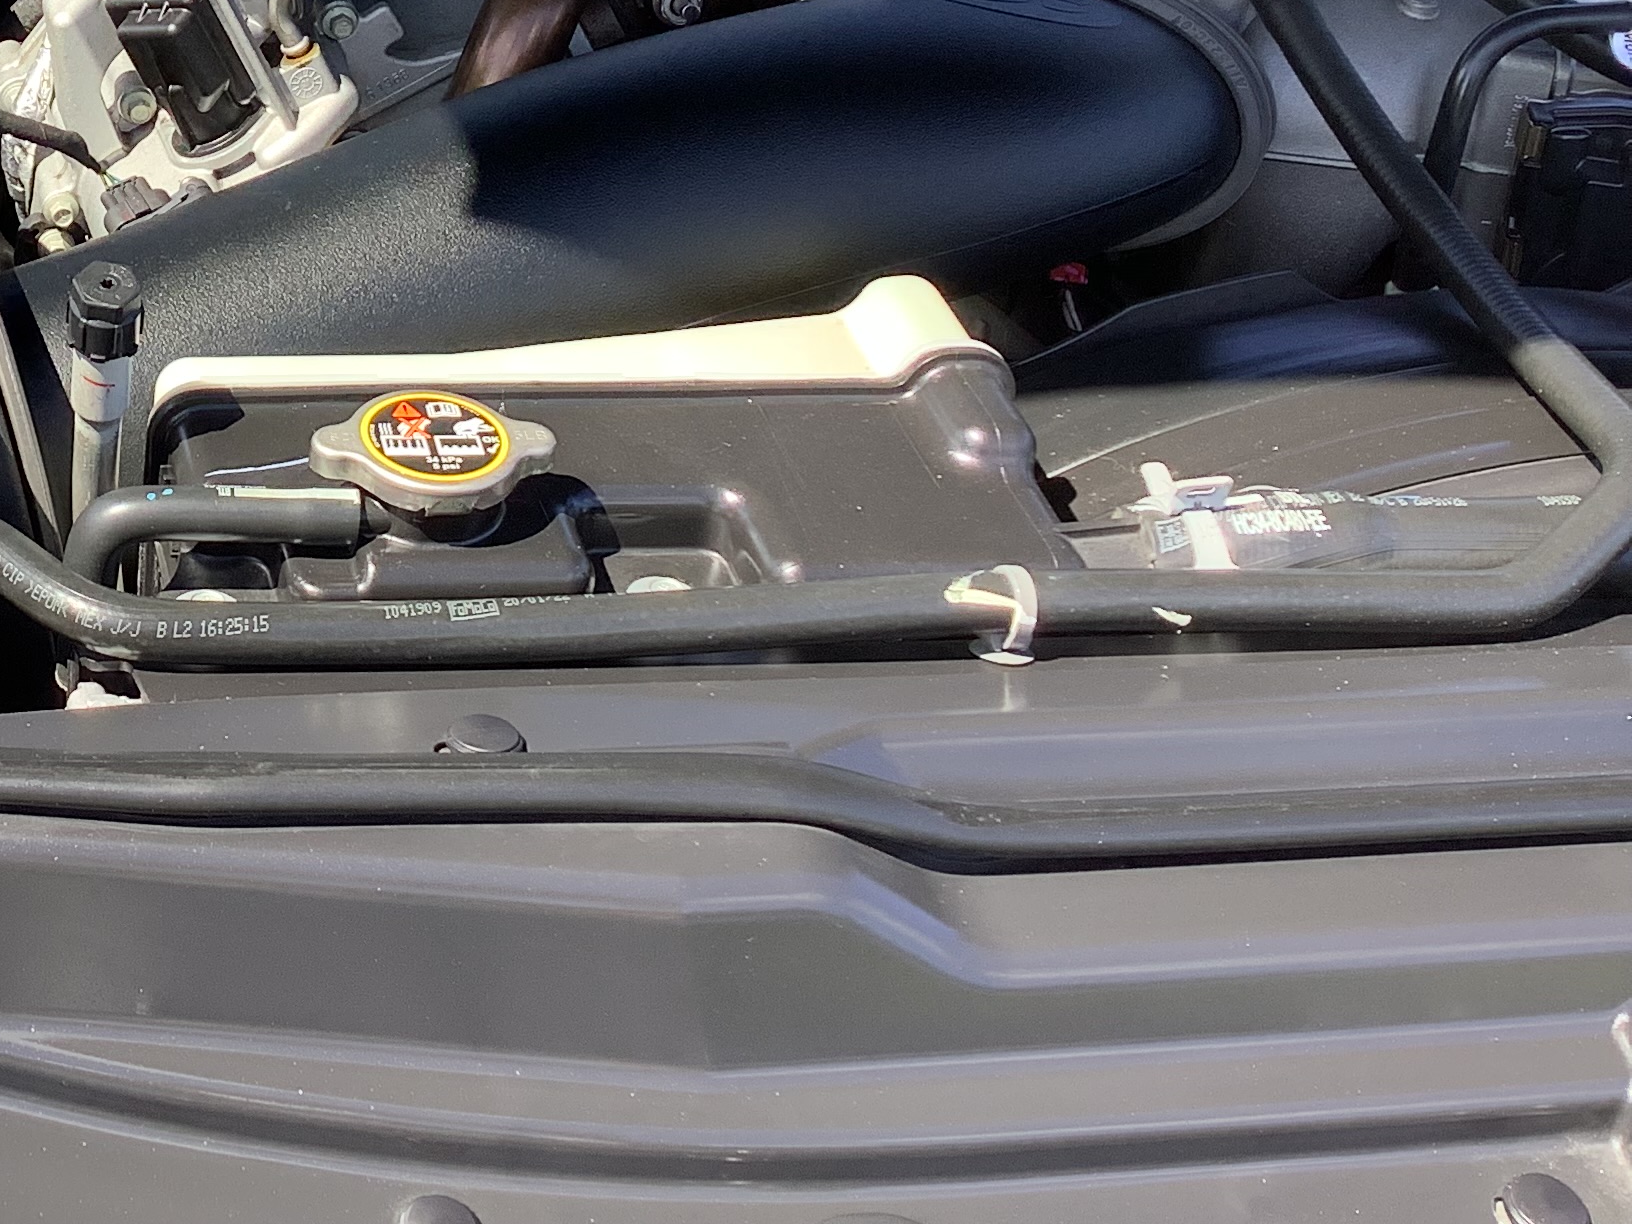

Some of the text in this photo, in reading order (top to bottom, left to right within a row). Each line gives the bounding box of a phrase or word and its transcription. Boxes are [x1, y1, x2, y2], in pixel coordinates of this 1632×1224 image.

[482, 436, 501, 444] OK
[441, 456, 463, 464] kPa
[442, 463, 461, 471] psi
[2, 561, 25, 586] CIP
[74, 608, 103, 632] MEX
[110, 620, 141, 638] J/J
[156, 621, 167, 638] B
[173, 621, 193, 638] L2
[199, 615, 269, 638] 16:25:15
